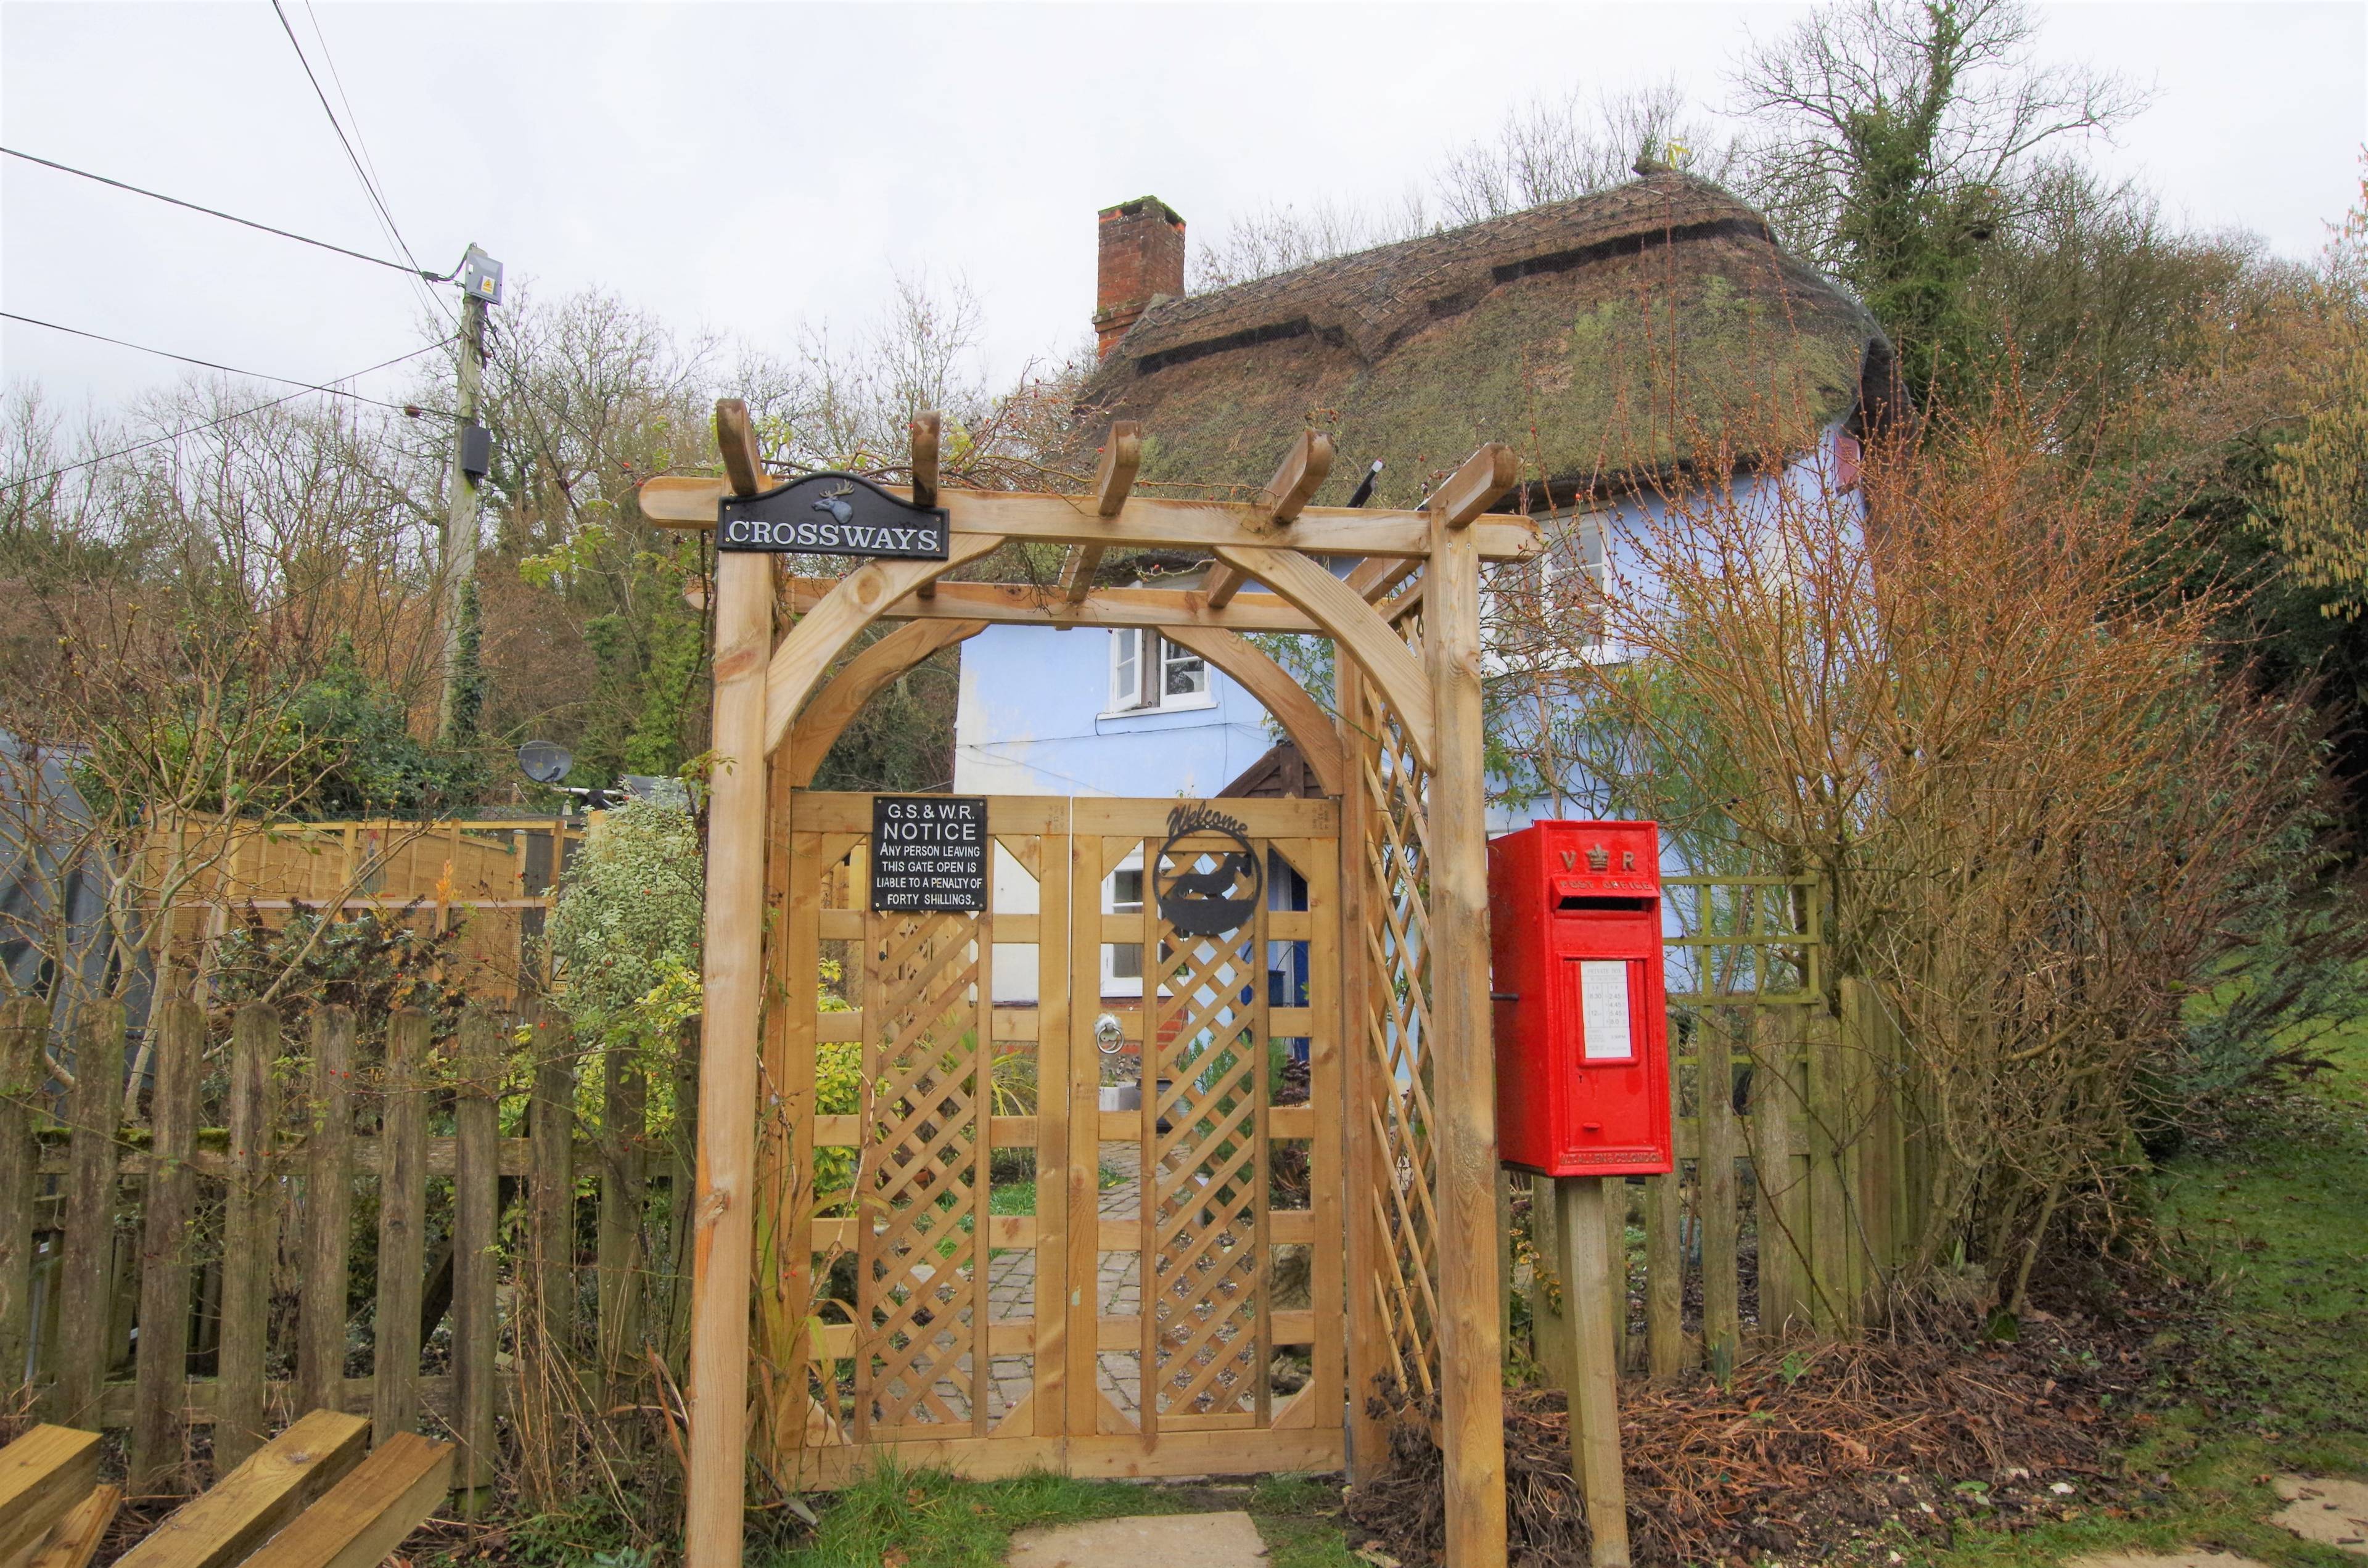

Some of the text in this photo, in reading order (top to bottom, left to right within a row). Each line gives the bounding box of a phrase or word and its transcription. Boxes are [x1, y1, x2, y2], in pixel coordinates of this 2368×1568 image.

[729, 520, 938, 551] CROSSWAYS
[1166, 800, 1249, 837] Welcome
[884, 822, 976, 840] NOTICE
[904, 845, 939, 856] PERSON
[943, 846, 980, 857] LEAVING
[882, 861, 977, 873] THIS GATE OPEN IS
[1560, 850, 1636, 872] V R
[877, 877, 982, 889] LIABLE TO A PENALTY OF
[1560, 880, 1653, 890] POST OFFICE
[887, 893, 975, 905] FORTY SHILLINGS.
